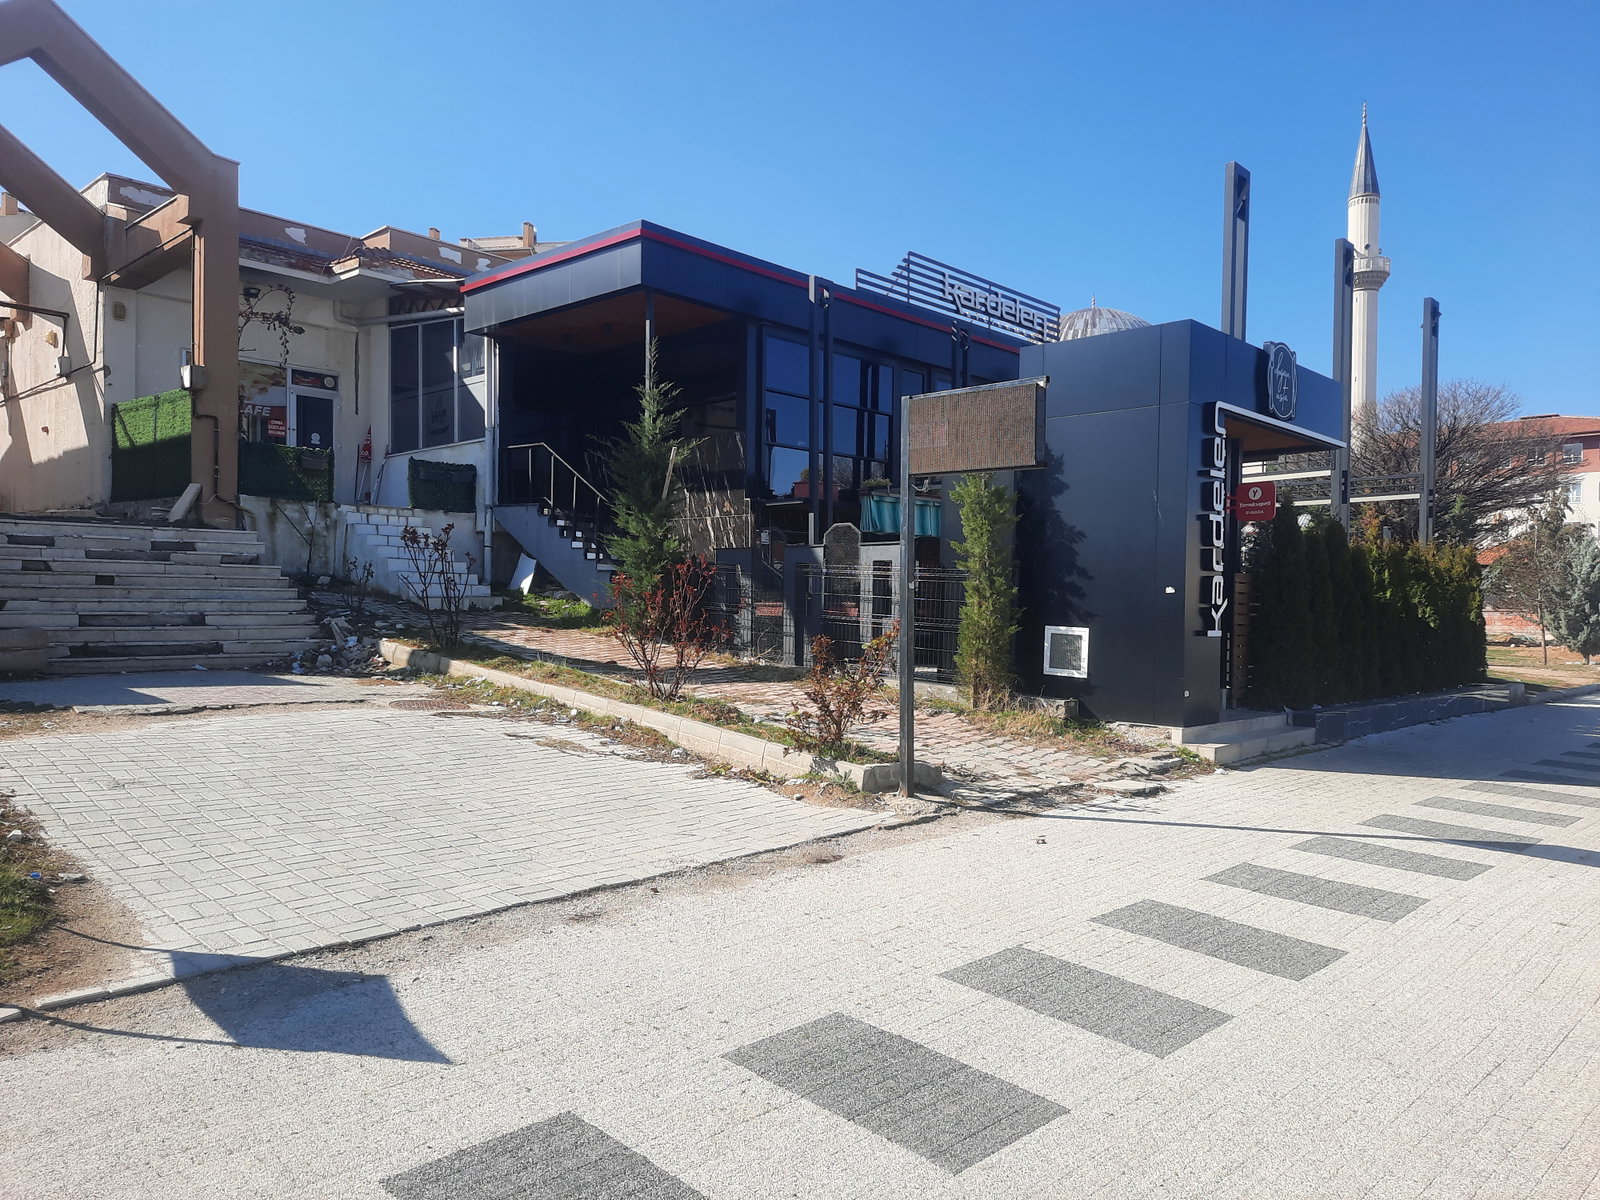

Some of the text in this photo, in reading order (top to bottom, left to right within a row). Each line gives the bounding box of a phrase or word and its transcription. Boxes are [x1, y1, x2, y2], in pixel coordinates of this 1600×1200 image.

[943, 272, 1048, 342] kardelen
[239, 404, 272, 417] AFE
[1207, 400, 1229, 638] kardelen
